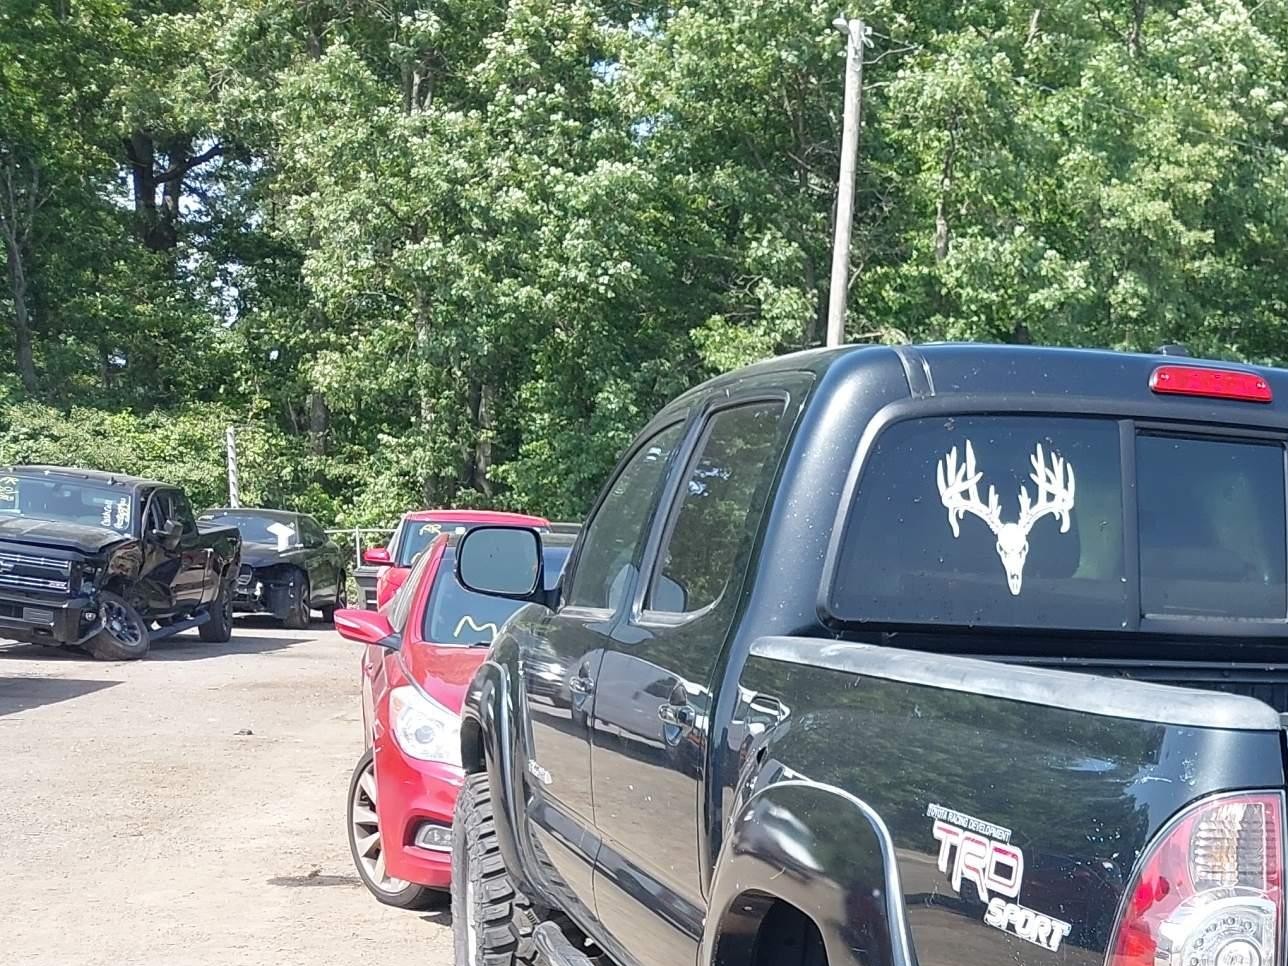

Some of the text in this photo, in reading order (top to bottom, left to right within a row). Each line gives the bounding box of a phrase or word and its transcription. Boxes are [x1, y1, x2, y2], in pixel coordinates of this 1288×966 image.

[947, 812, 969, 827] RACING
[933, 820, 1024, 903] TRD
[984, 897, 1072, 952] SPORT
